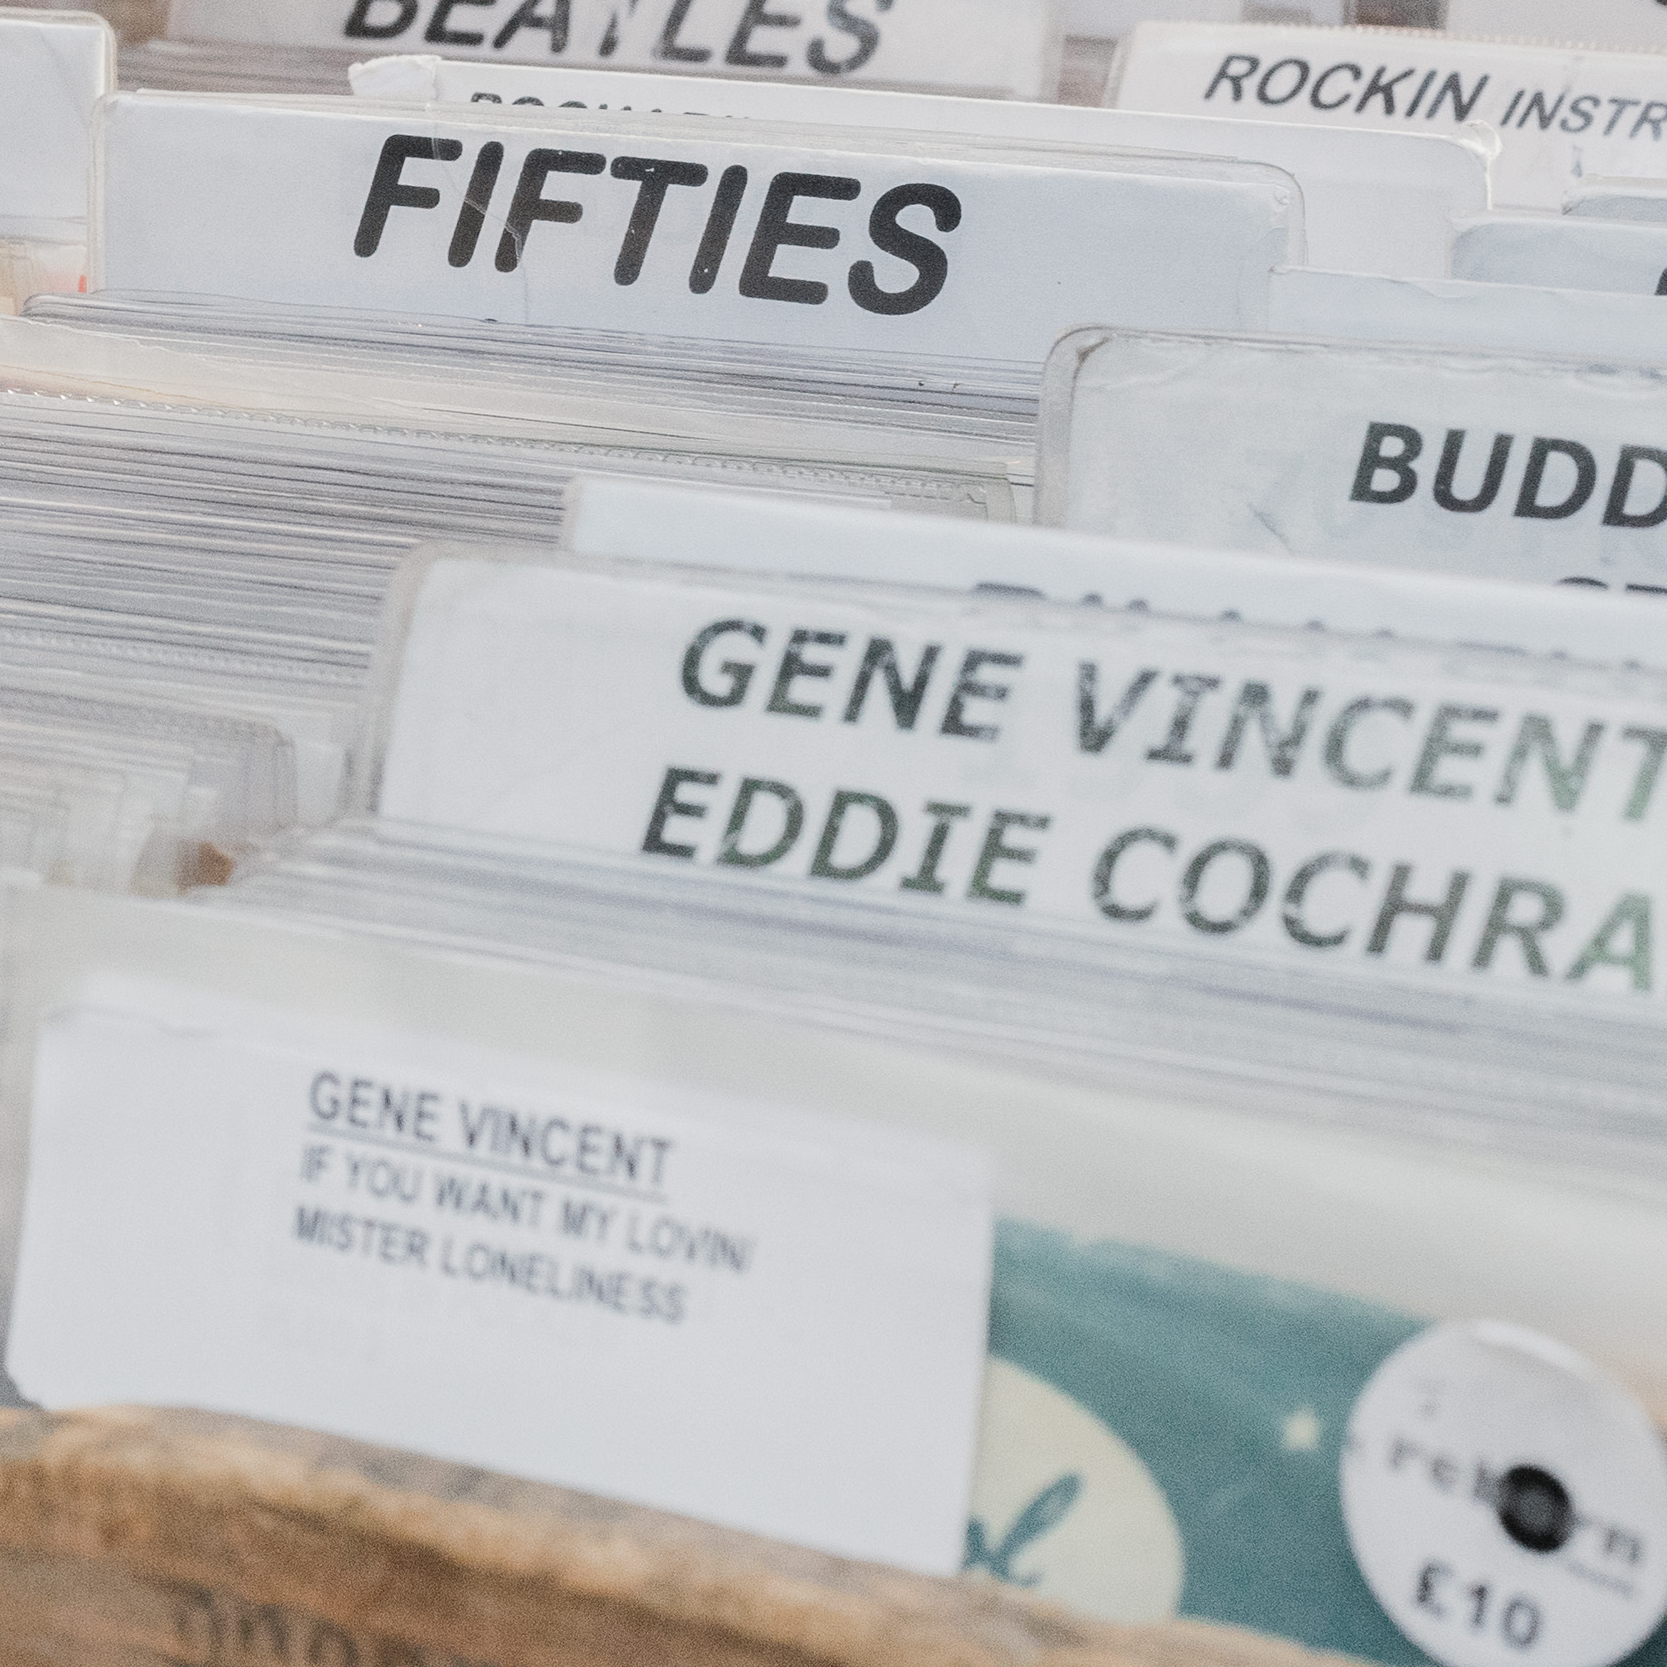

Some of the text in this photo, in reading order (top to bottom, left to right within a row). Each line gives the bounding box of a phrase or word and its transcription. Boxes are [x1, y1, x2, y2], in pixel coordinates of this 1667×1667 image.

[1204, 52, 1491, 123] ROCKIN
[353, 133, 963, 316] FIFTIES
[678, 618, 1667, 825] GENE VINCENT
[640, 764, 1657, 994] EDDIE COCHRA
[308, 1069, 675, 1188] GENE VINCENT
[298, 1143, 334, 1184] IF
[344, 1156, 426, 1206] YOU
[433, 1173, 548, 1230] WANT
[560, 1197, 619, 1242] MY
[293, 1204, 688, 1327] MISTER LONELINESS
[1413, 1558, 1544, 1652] £10
